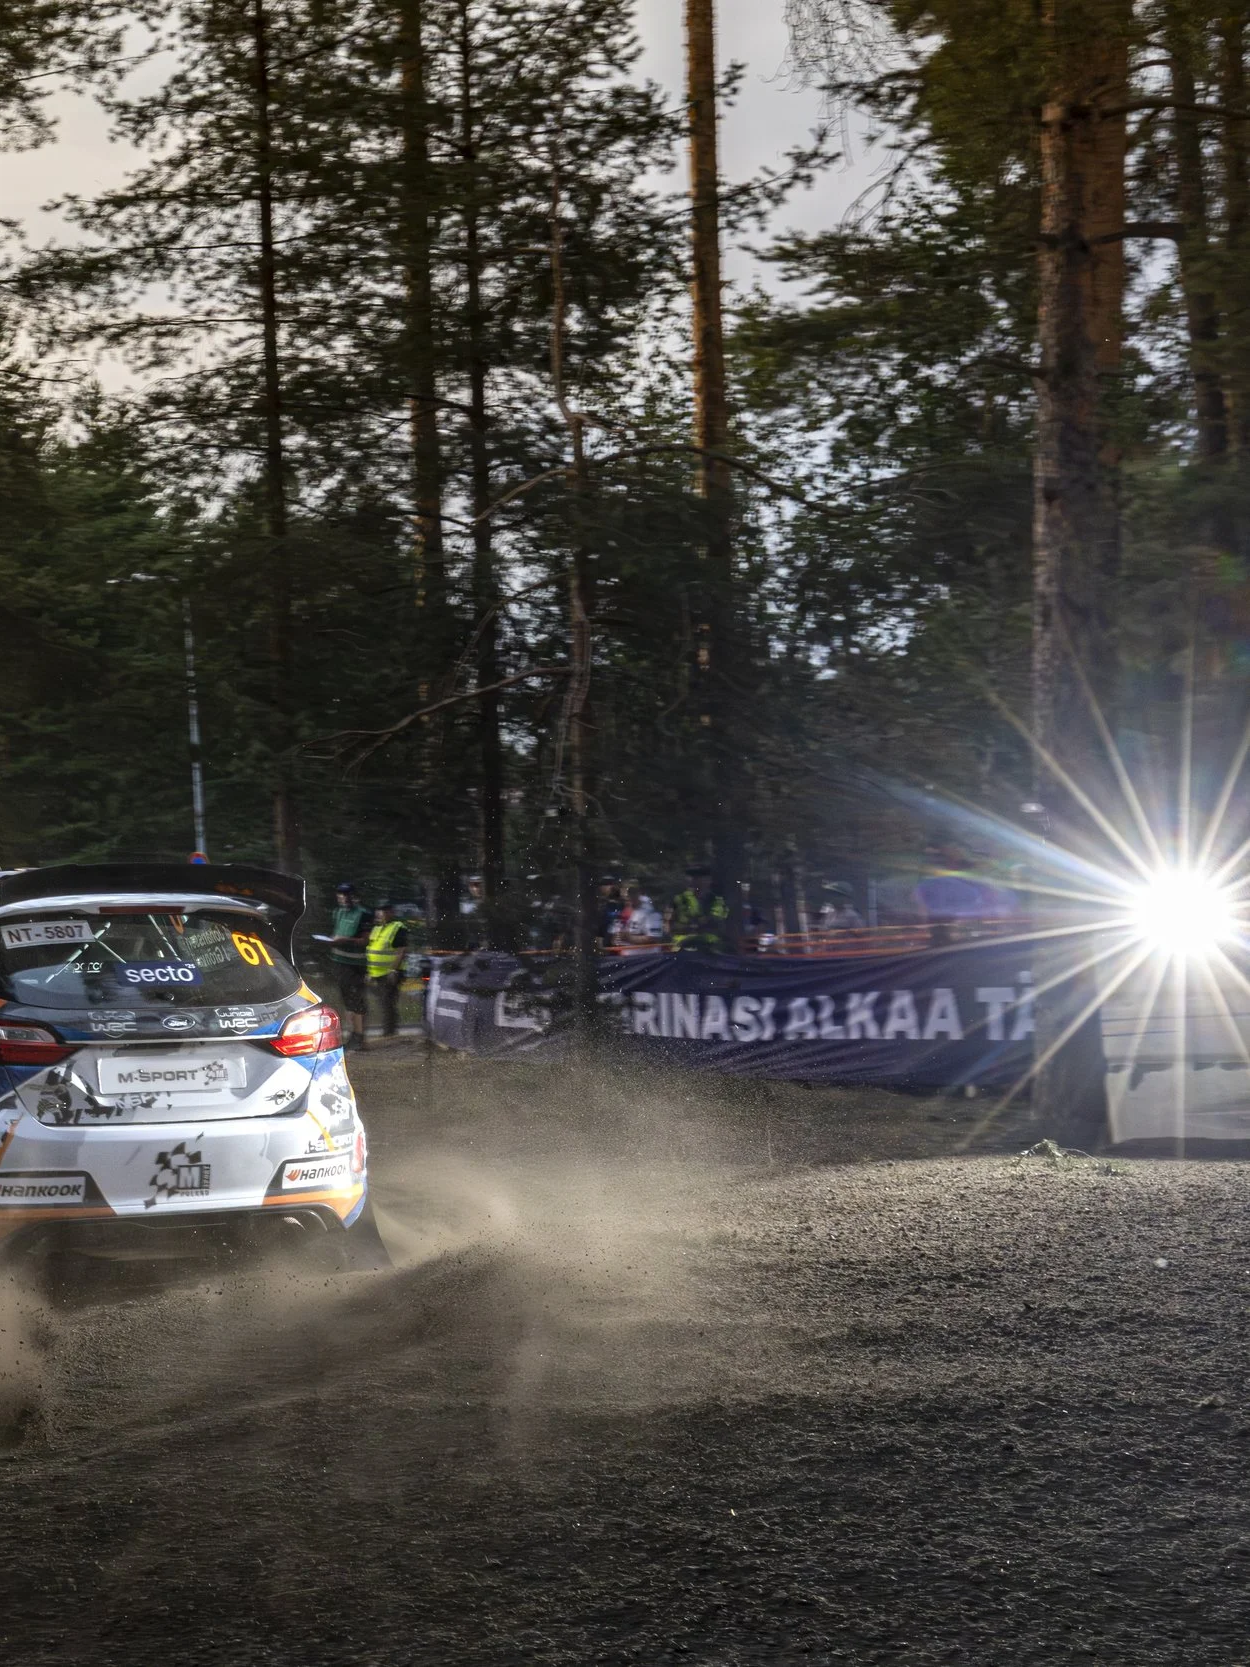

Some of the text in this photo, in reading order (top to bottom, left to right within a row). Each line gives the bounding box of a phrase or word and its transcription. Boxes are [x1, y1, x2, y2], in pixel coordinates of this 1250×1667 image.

[231, 931, 274, 966] 61
[125, 964, 194, 983] secto
[219, 1017, 259, 1029] WRC
[118, 1069, 198, 1084] M-SPORT
